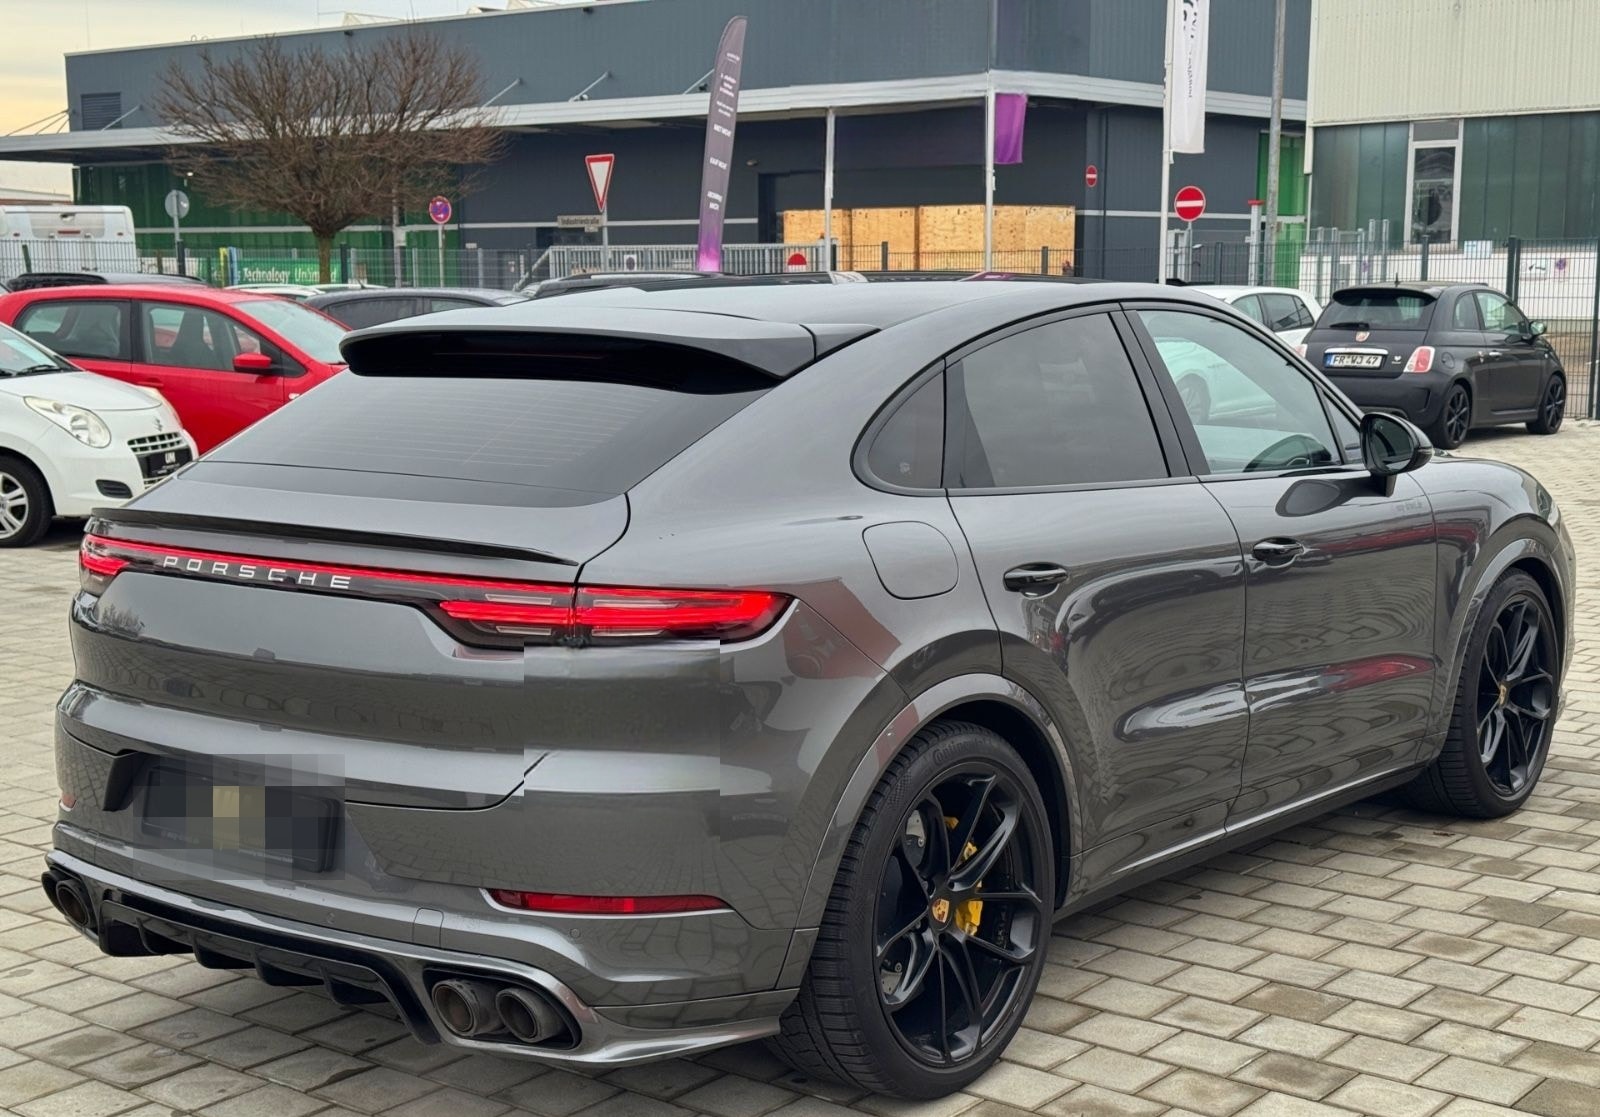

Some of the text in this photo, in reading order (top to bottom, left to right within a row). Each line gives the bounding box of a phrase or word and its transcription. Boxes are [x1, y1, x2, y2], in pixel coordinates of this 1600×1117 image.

[243, 267, 290, 284] Technology
[294, 267, 336, 282] Unlimd
[163, 556, 351, 589] PORSCHE
